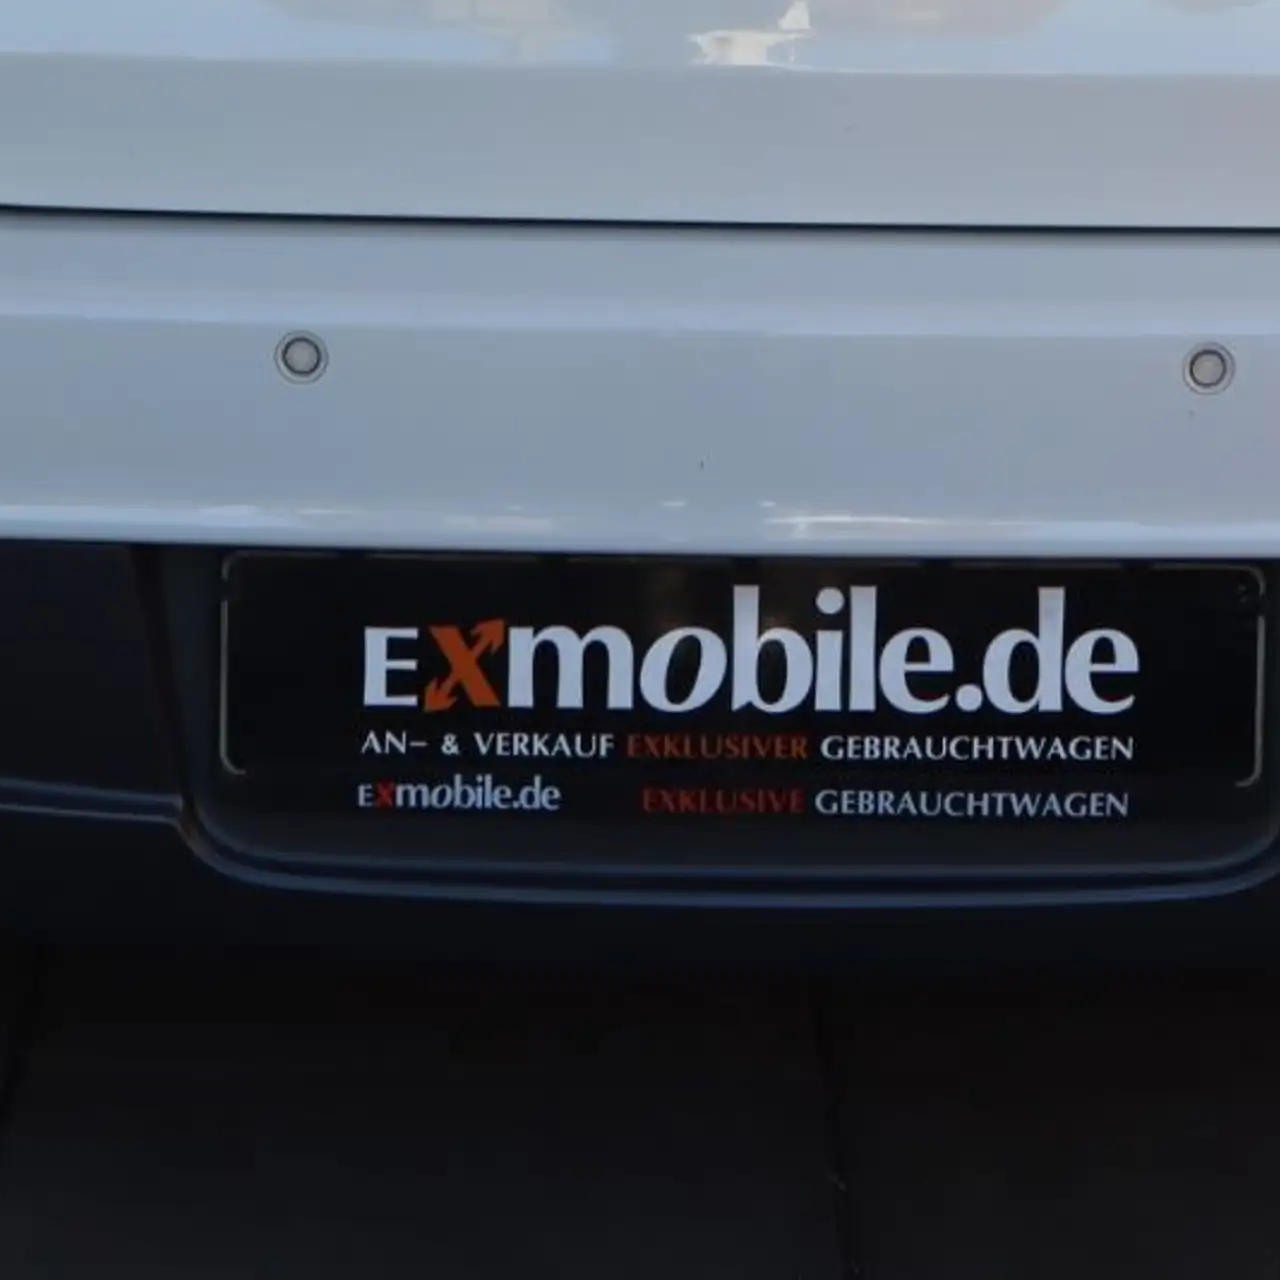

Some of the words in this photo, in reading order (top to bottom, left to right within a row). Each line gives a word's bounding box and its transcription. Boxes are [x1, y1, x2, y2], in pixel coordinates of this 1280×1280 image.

[440, 733, 460, 756] &
[474, 732, 615, 758] VERKAUF
[627, 733, 808, 759] EXKLUSIVER
[820, 735, 1134, 761] GEBRAUCHTWAGEN
[642, 787, 804, 814] EXKLUSIVE
[815, 789, 1130, 817] GEBRAUCHTWAGEN
